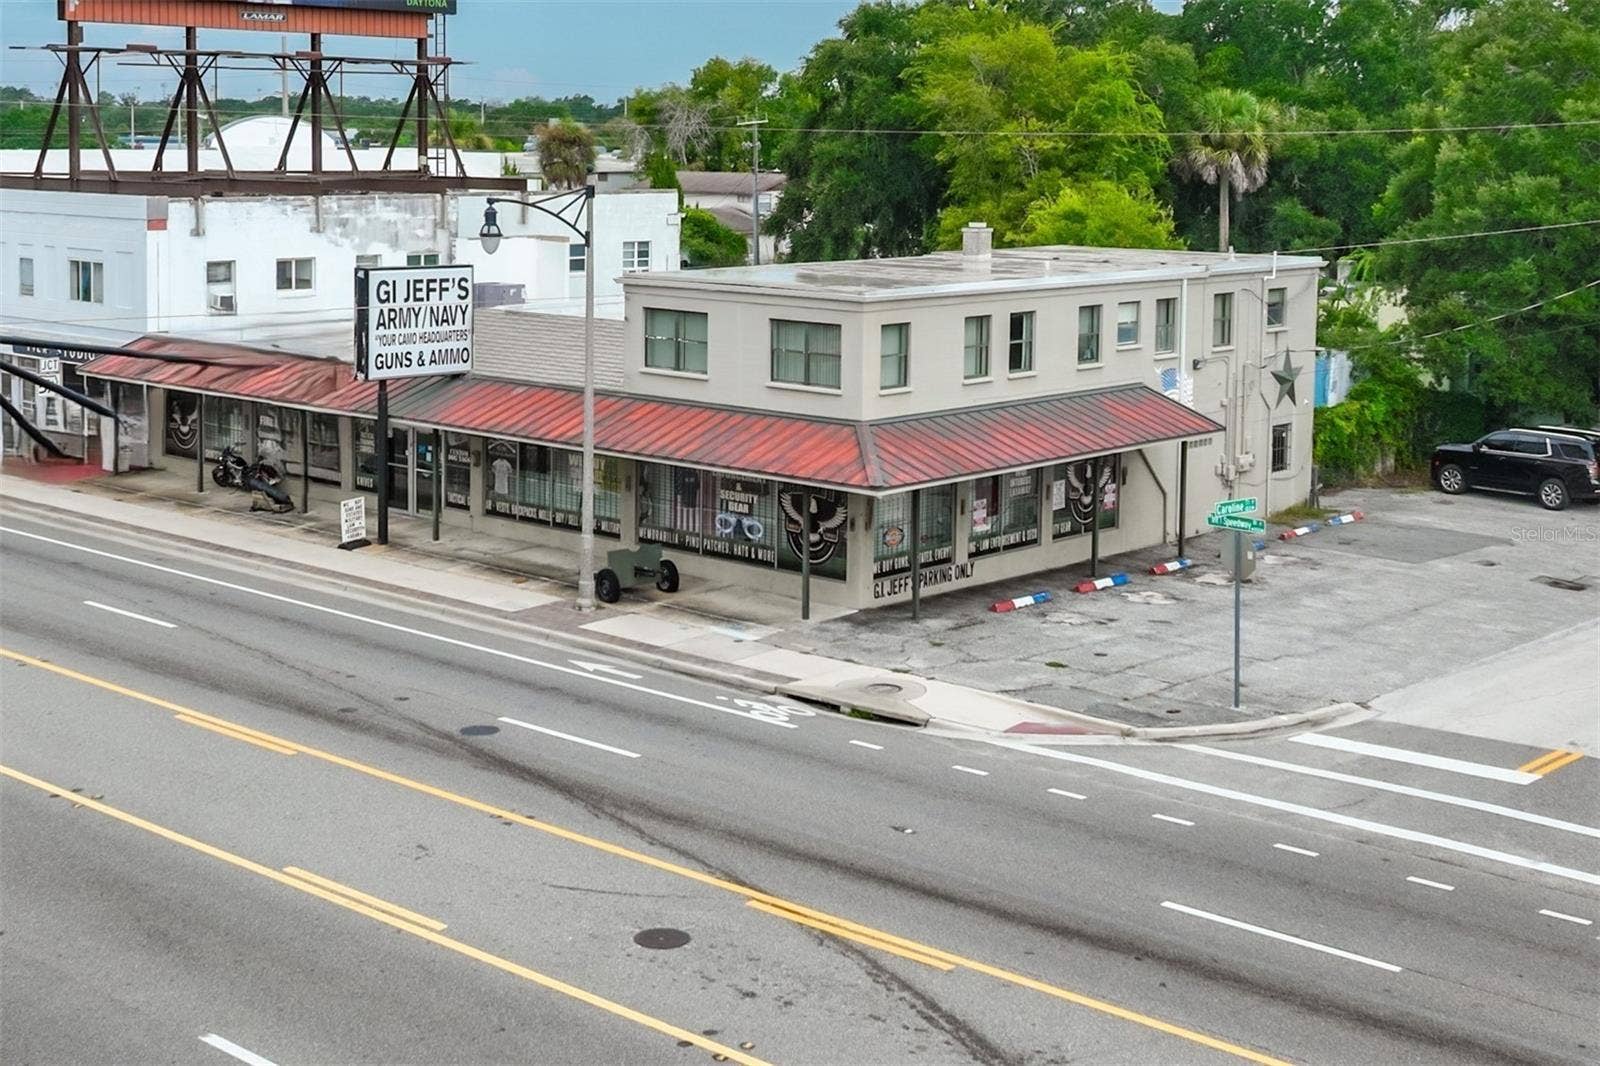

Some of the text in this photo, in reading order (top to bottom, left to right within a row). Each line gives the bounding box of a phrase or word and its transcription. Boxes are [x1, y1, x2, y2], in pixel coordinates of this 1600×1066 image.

[406, 0, 448, 8] DAYTONA
[243, 13, 284, 21] LAMAR
[376, 277, 469, 304] GI JEFF'S
[376, 304, 469, 330] ARMY/NAVY
[398, 332, 417, 345] CAMO
[42, 359, 58, 370] JCT
[374, 347, 470, 370] GUNS & AMMO
[720, 490, 759, 504] SECURITY
[727, 502, 749, 514] GEAR
[954, 561, 975, 580] ONLY
